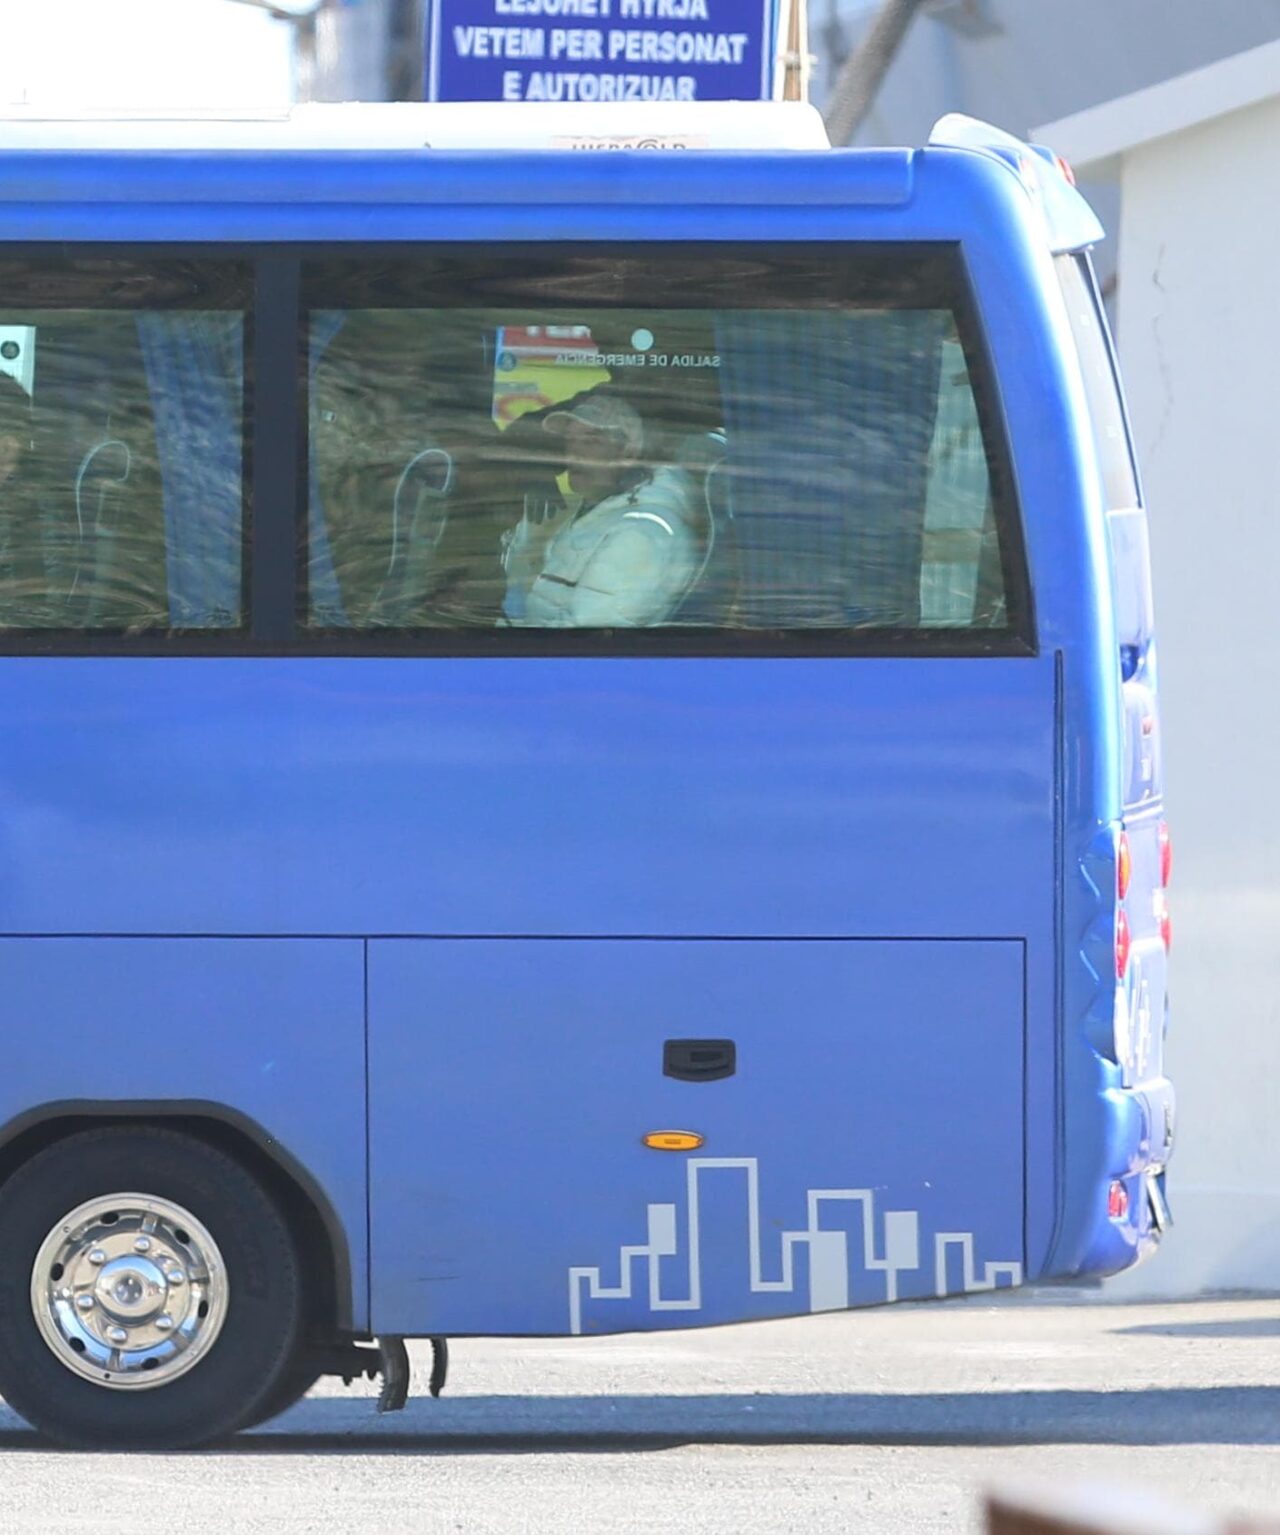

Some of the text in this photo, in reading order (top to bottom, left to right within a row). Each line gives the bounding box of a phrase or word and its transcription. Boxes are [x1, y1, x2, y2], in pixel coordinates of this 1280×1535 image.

[454, 26, 748, 63] VETEM PER PERSONAT
[503, 70, 697, 101] E AUTORIZUAR
